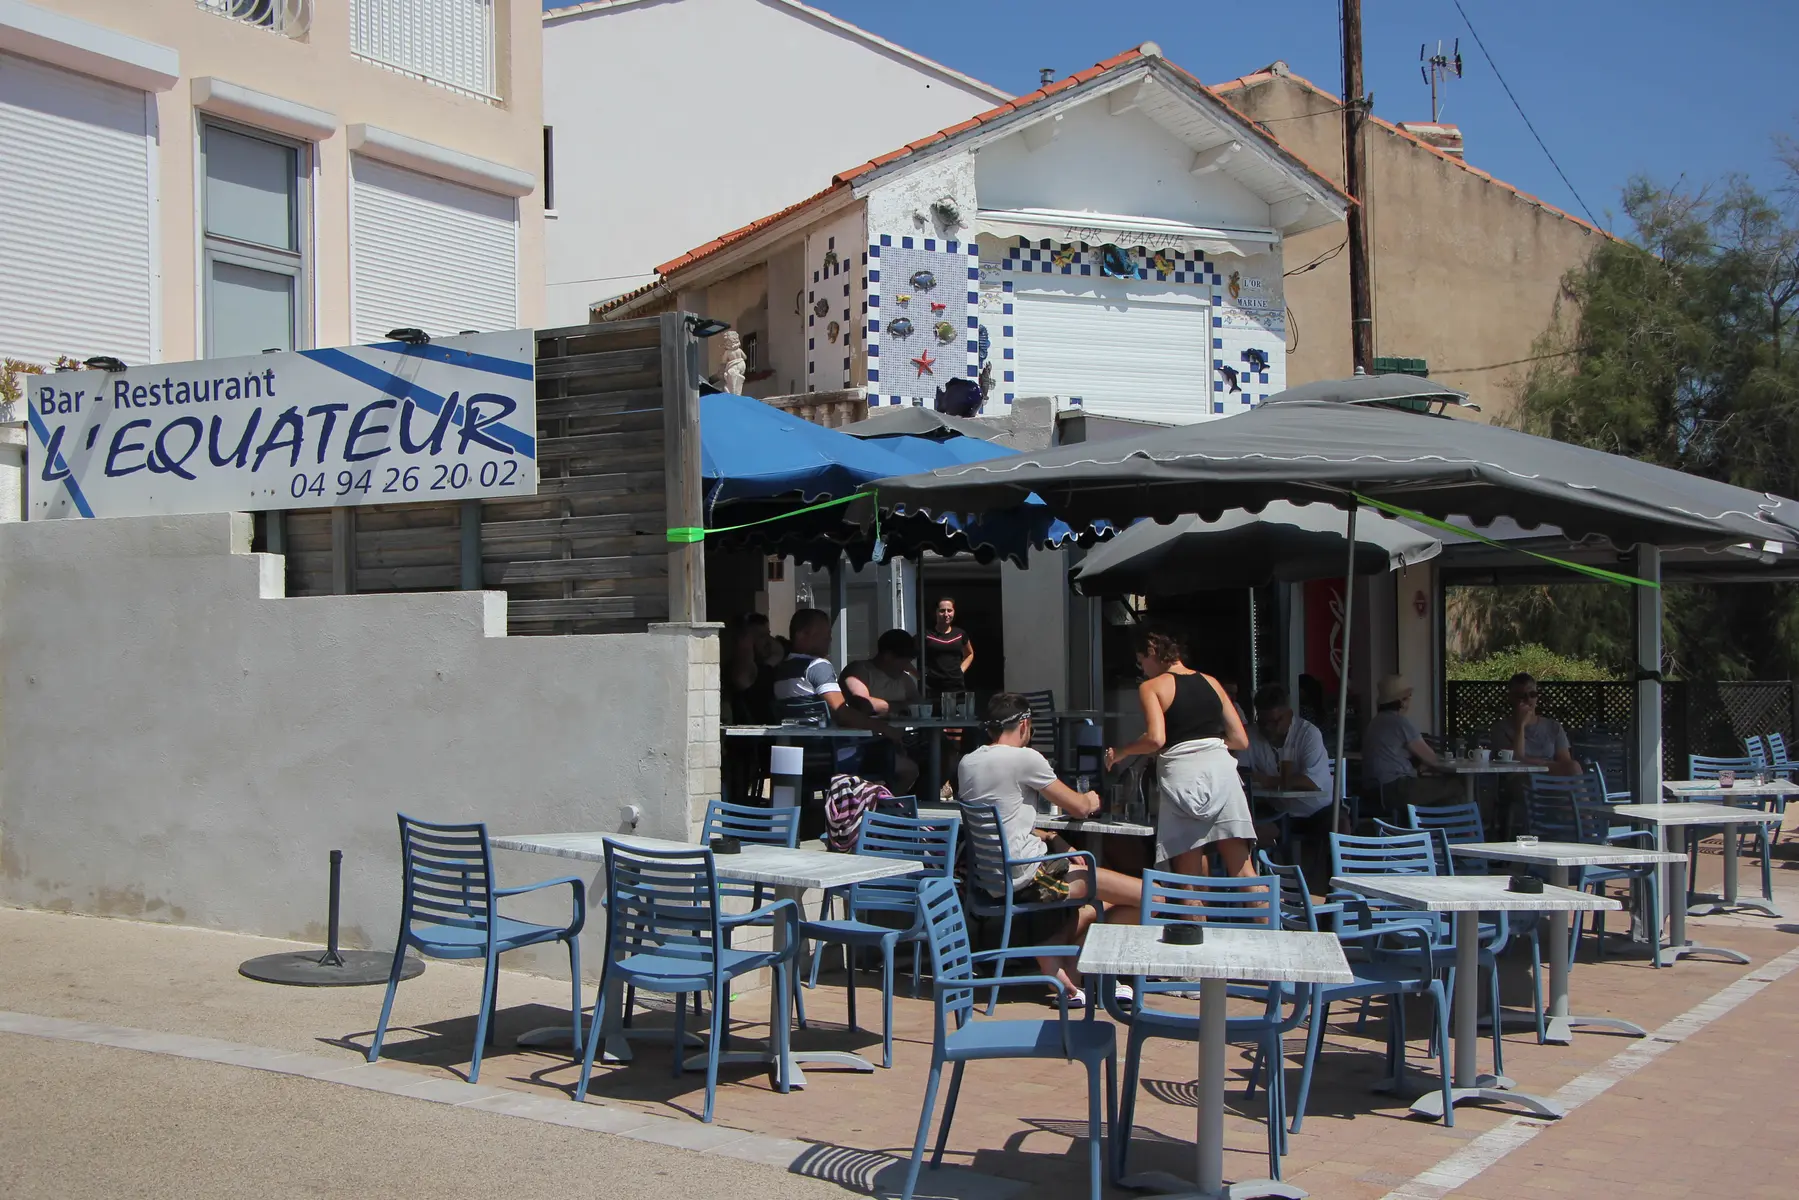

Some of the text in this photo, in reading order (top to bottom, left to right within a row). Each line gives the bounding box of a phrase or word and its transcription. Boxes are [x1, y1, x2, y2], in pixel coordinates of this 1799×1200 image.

[1115, 230, 1184, 248] MARINE
[1237, 298, 1268, 308] MARINE
[40, 386, 85, 415] Bar
[114, 368, 276, 409] Restaurant
[42, 391, 517, 481] L'EQUATEUR
[291, 460, 518, 498] 04 94 26 20 02
